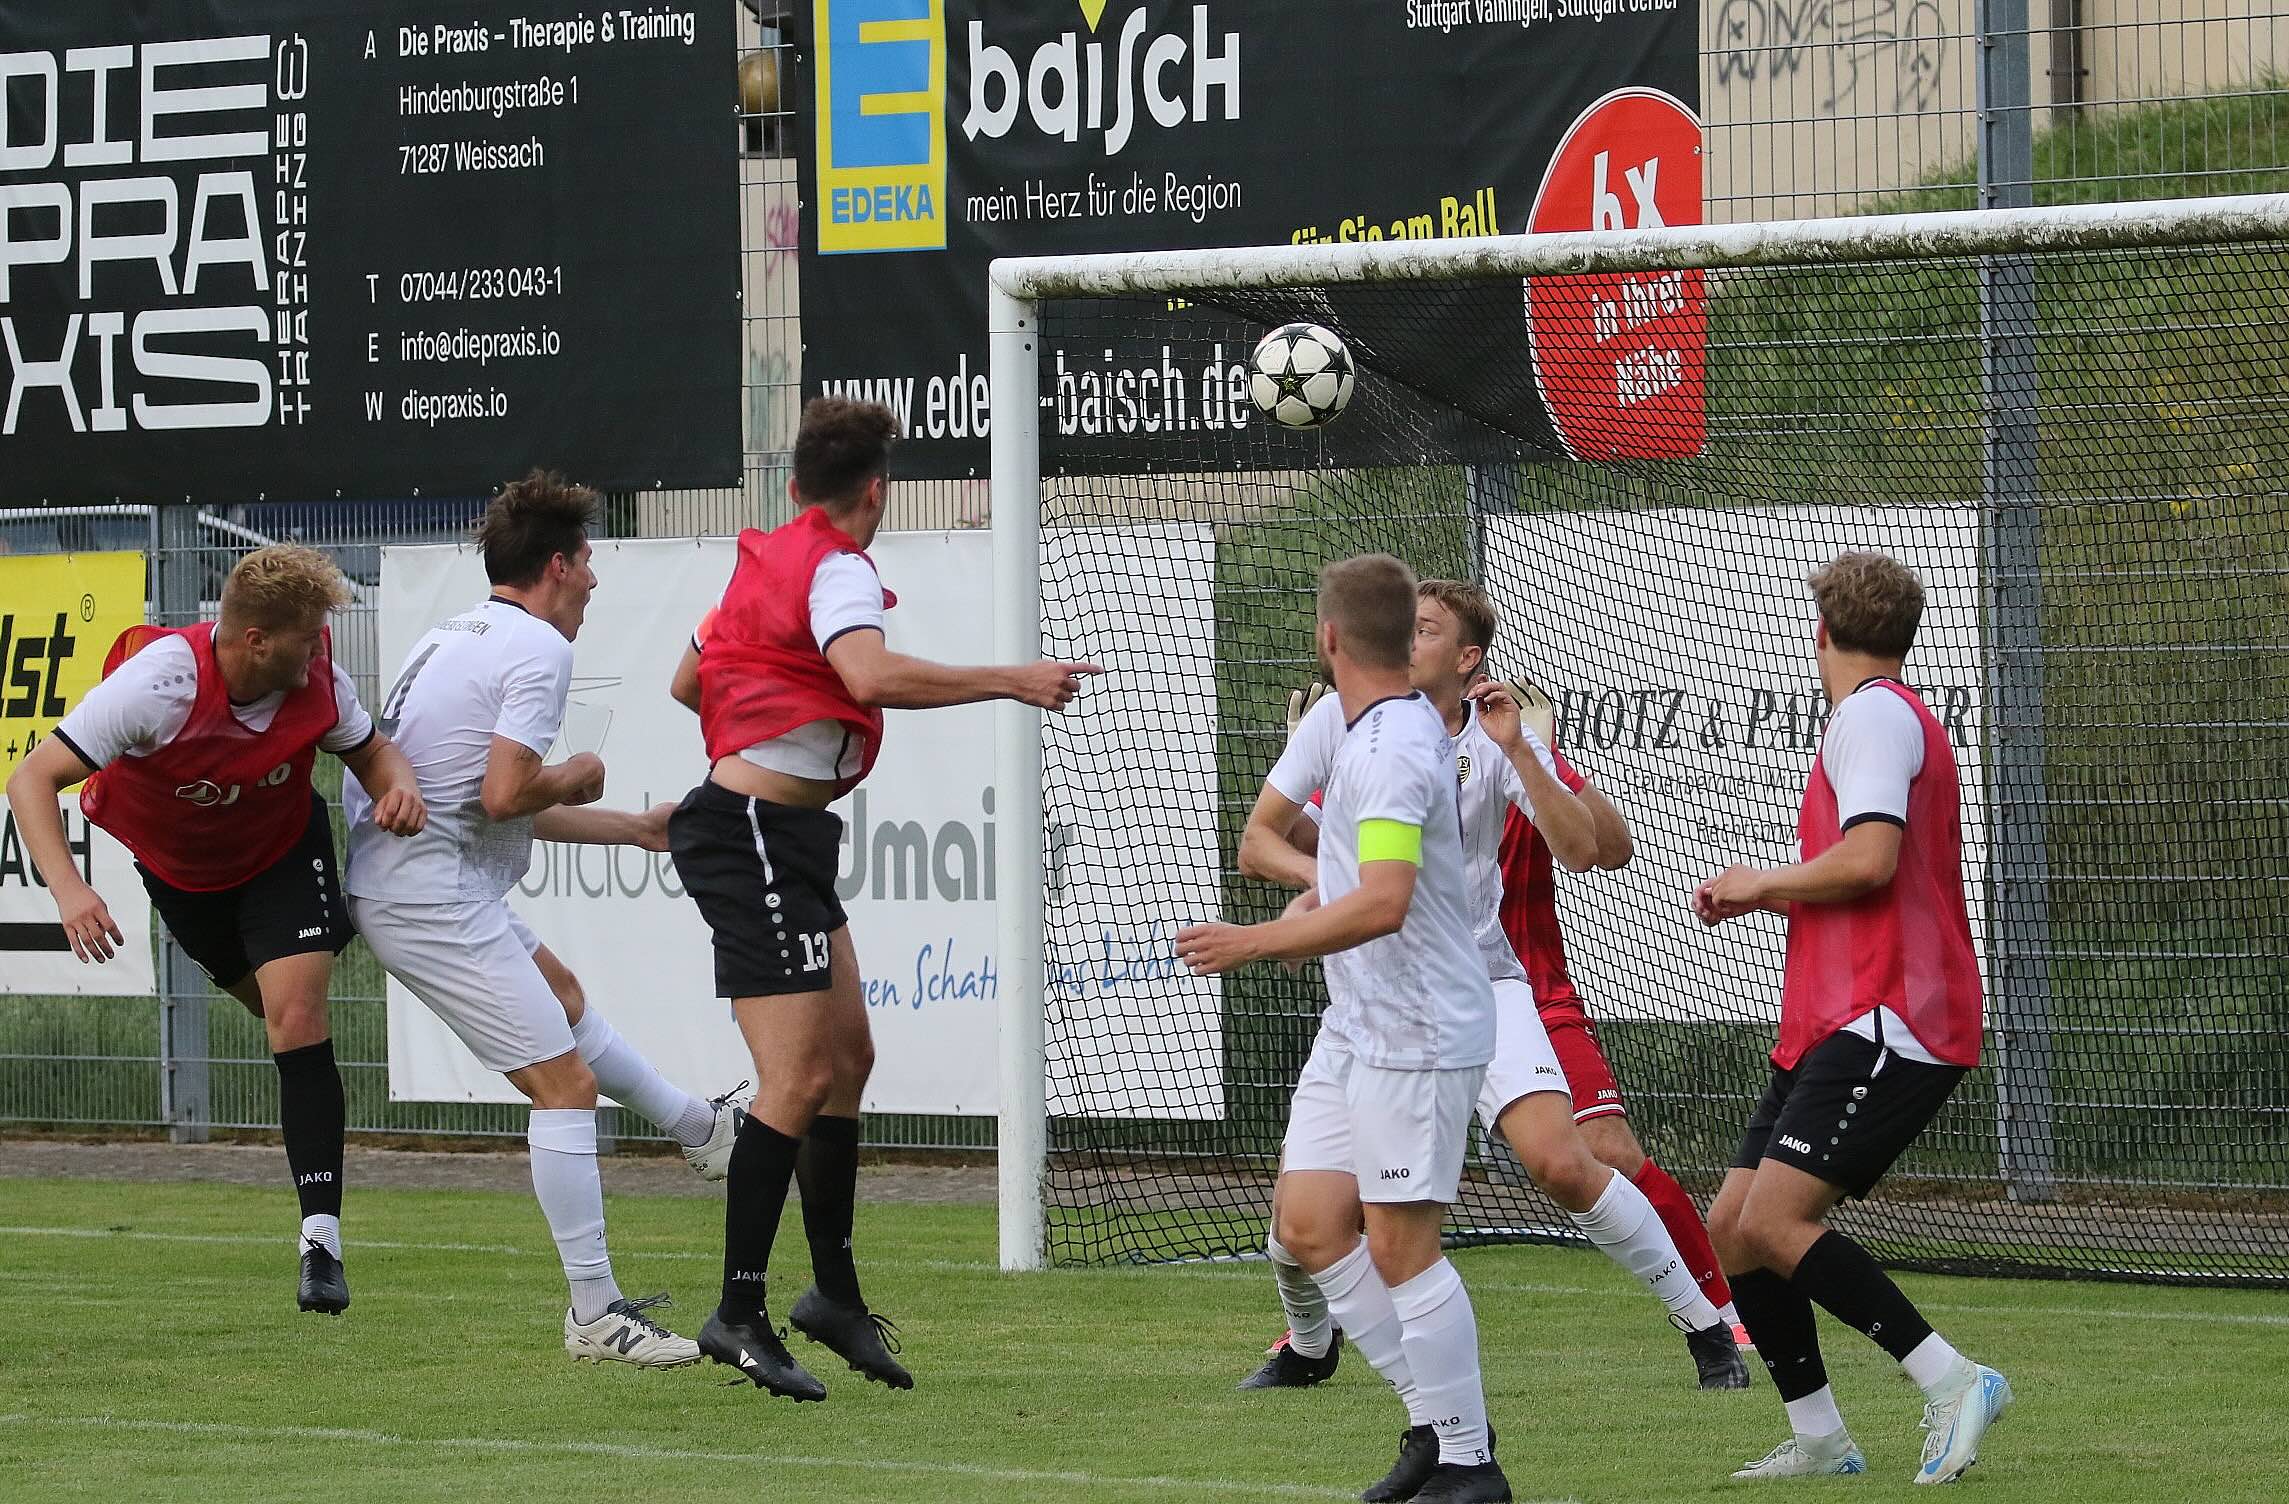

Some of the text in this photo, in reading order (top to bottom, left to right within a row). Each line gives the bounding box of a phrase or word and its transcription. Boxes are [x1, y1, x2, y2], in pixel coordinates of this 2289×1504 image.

[364, 30, 376, 59] A
[400, 25, 428, 57] Die
[434, 20, 489, 54] Praxis
[509, 12, 594, 53] Therapie
[601, 12, 615, 42] &
[619, 5, 695, 45] Training
[1407, 0, 1471, 33] Stuttgart
[0, 34, 271, 171] DIE
[400, 75, 578, 118] Hindenburgstraße 1
[399, 135, 544, 175] 71287 Weissach
[831, 183, 934, 224] EDEKA
[966, 168, 1241, 224] mein Herz für die Region
[1441, 187, 1499, 238] Ball
[0, 170, 270, 303] PRA
[276, 112, 293, 425] THERAPIE
[293, 111, 311, 425] TRAINING
[366, 265, 562, 304] T 07044/233 043-1
[1592, 270, 1685, 343] in Ihrer
[368, 324, 561, 366] E info@diepraxis.io
[0, 305, 272, 434] XIS
[1615, 345, 1683, 408] Nähe
[365, 387, 507, 427] W diepraxis.io
[1556, 688, 1686, 750] HOTZ
[1701, 698, 1726, 749] &
[1699, 815, 1797, 846] Rechtsanw
[298, 925, 322, 939] JAKO
[799, 931, 829, 972] 13
[1534, 1065, 1557, 1076] JAKO
[1597, 1088, 1618, 1100] JAKO
[1779, 1134, 1812, 1155] JAKO
[299, 1171, 333, 1186] JAKO
[1380, 1167, 1410, 1180] JAKO
[732, 1270, 768, 1282] JAKO
[1649, 1259, 1677, 1285] JAKO
[1431, 1416, 1460, 1428] AKO
